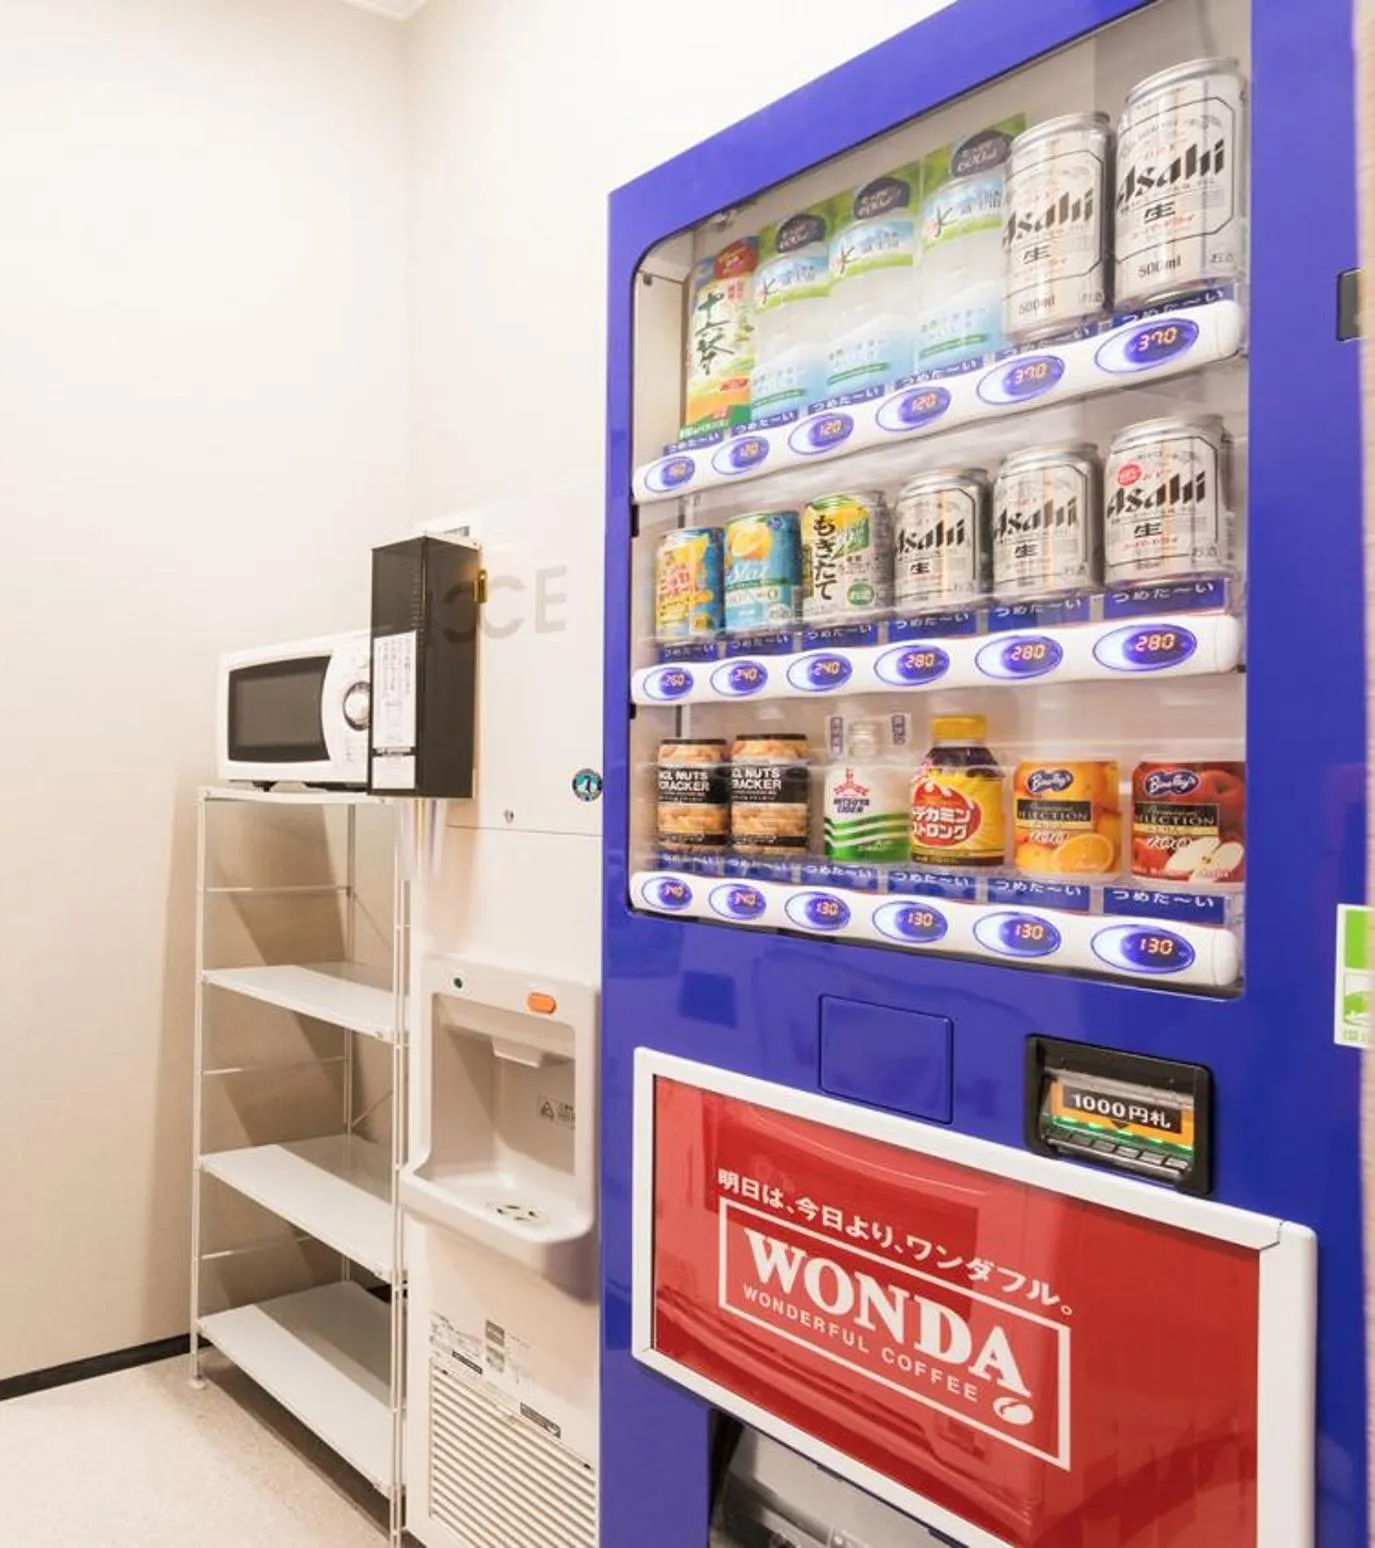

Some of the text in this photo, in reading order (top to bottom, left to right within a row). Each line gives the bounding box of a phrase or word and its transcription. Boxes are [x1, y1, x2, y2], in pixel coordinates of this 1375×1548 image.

[1117, 138, 1224, 210] Asahi
[1002, 188, 1094, 247] Asahi
[1144, 201, 1176, 224] 生
[1024, 245, 1051, 264] 生
[1138, 326, 1177, 351] 370
[1015, 363, 1048, 386] 370
[1106, 470, 1206, 520] Asahi
[993, 498, 1077, 540] Asahi
[1133, 522, 1163, 538] 生
[897, 519, 964, 554] Asahi
[813, 514, 837, 601] もぎたて
[1011, 643, 1046, 662] 280
[1135, 633, 1175, 653] 280
[904, 653, 935, 669] 280
[675, 770, 709, 781] NUTS
[745, 767, 781, 779] NUTS
[816, 902, 839, 916] 130
[908, 912, 933, 928] 130
[1015, 923, 1045, 940] 130
[1140, 937, 1173, 955] 130
[1072, 1093, 1171, 1129] 1000円札
[717, 1168, 1073, 1317] 明日は、今日より、ワンダフル。
[743, 1228, 1032, 1398] WONDA
[743, 1283, 979, 1404] WONDERFUL COFFEE
